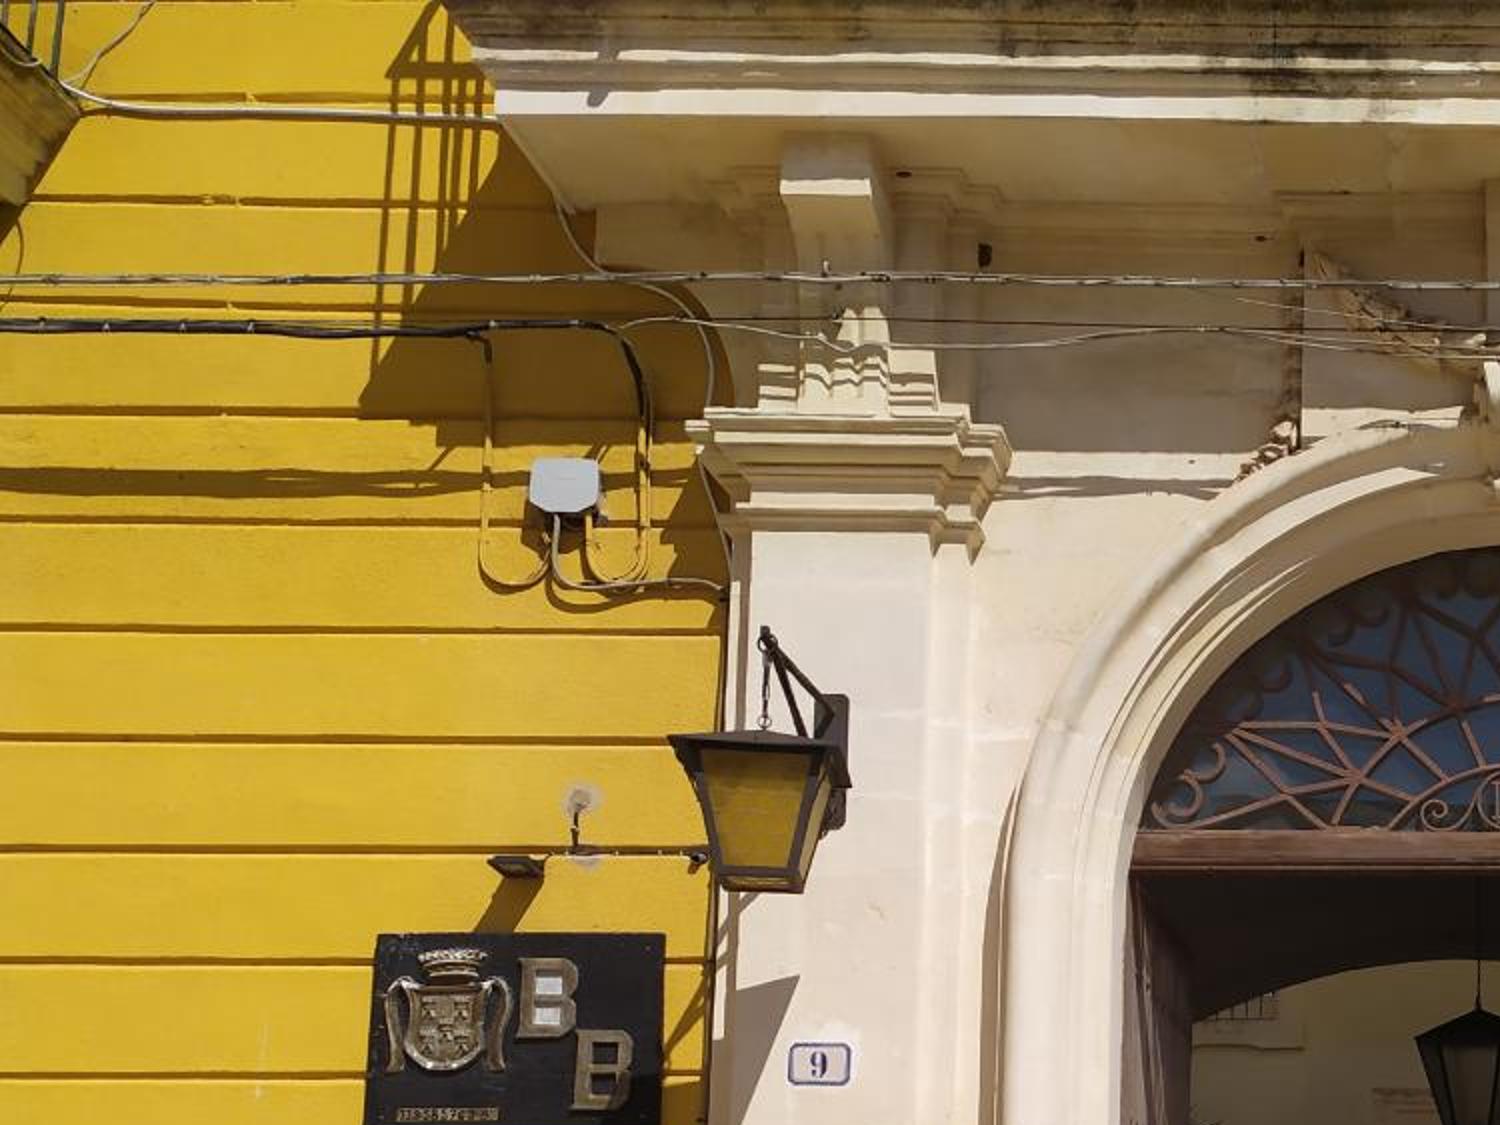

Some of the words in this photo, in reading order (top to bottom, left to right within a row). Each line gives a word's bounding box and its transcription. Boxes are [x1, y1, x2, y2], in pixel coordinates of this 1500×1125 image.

[516, 957, 579, 1039] B
[570, 1030, 635, 1111] B
[809, 1051, 828, 1079] 9
